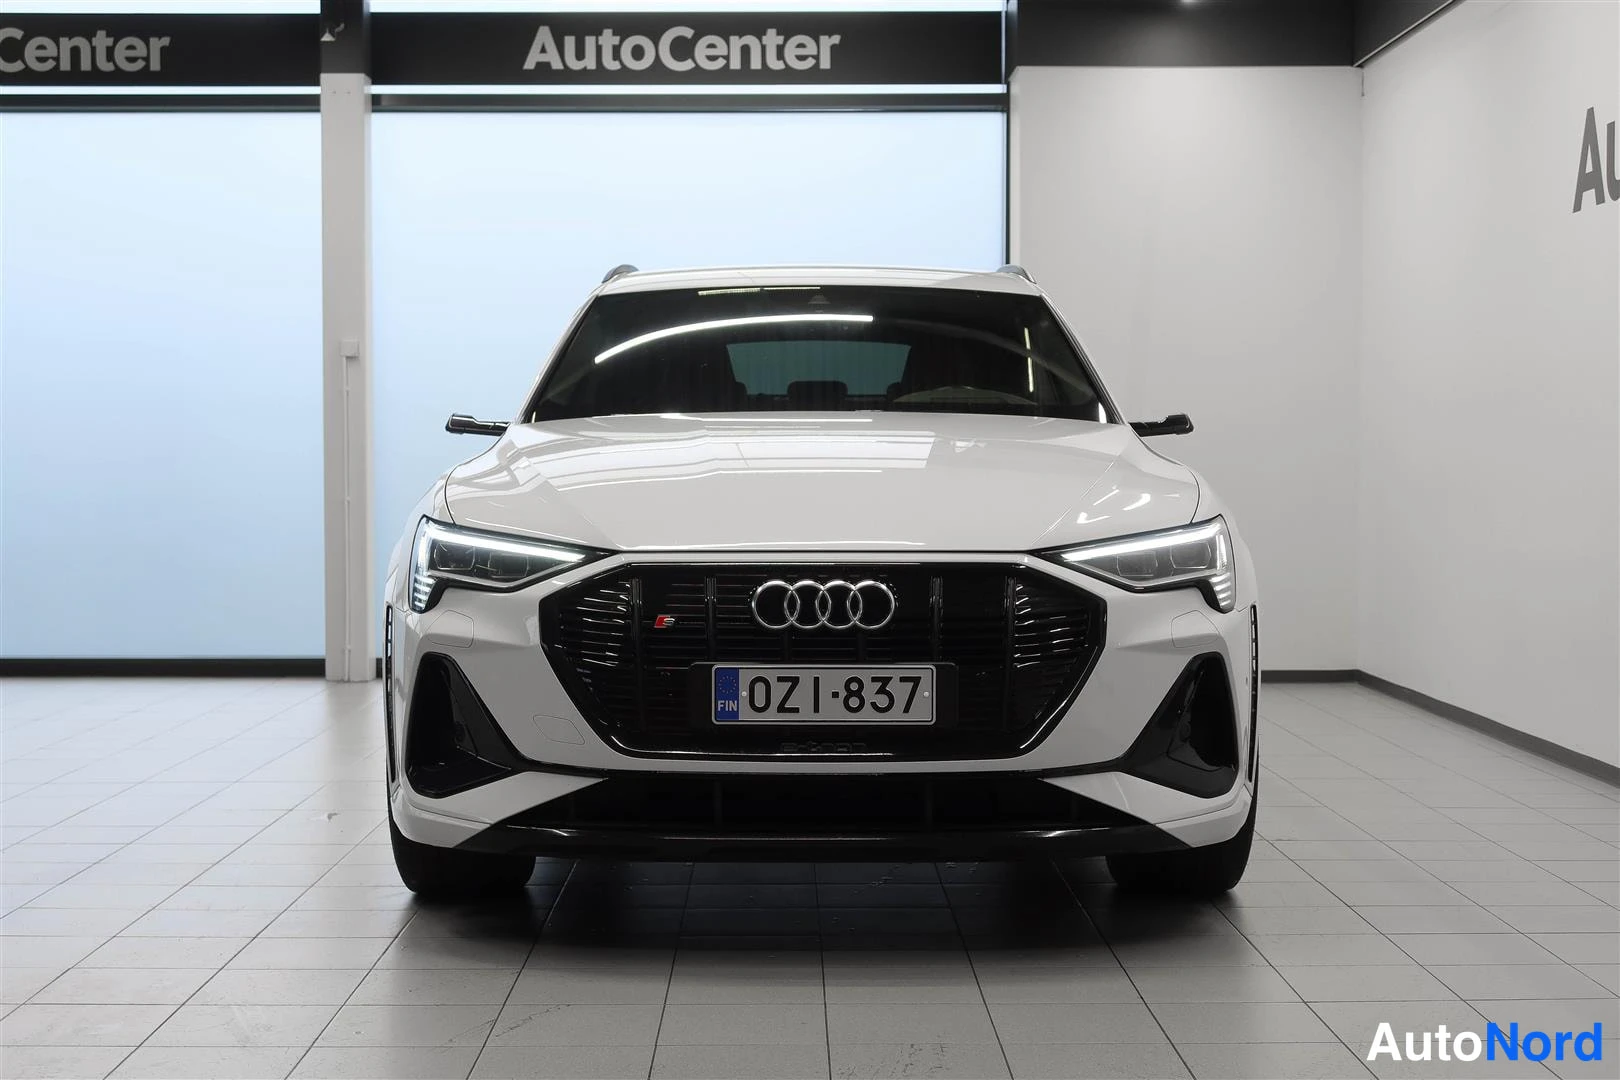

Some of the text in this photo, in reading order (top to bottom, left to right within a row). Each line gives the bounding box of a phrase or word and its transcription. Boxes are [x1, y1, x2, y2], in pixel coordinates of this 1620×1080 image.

[0, 28, 170, 72] Center
[523, 26, 841, 72] AutoCenter
[717, 675, 922, 714] FIN OZI-837
